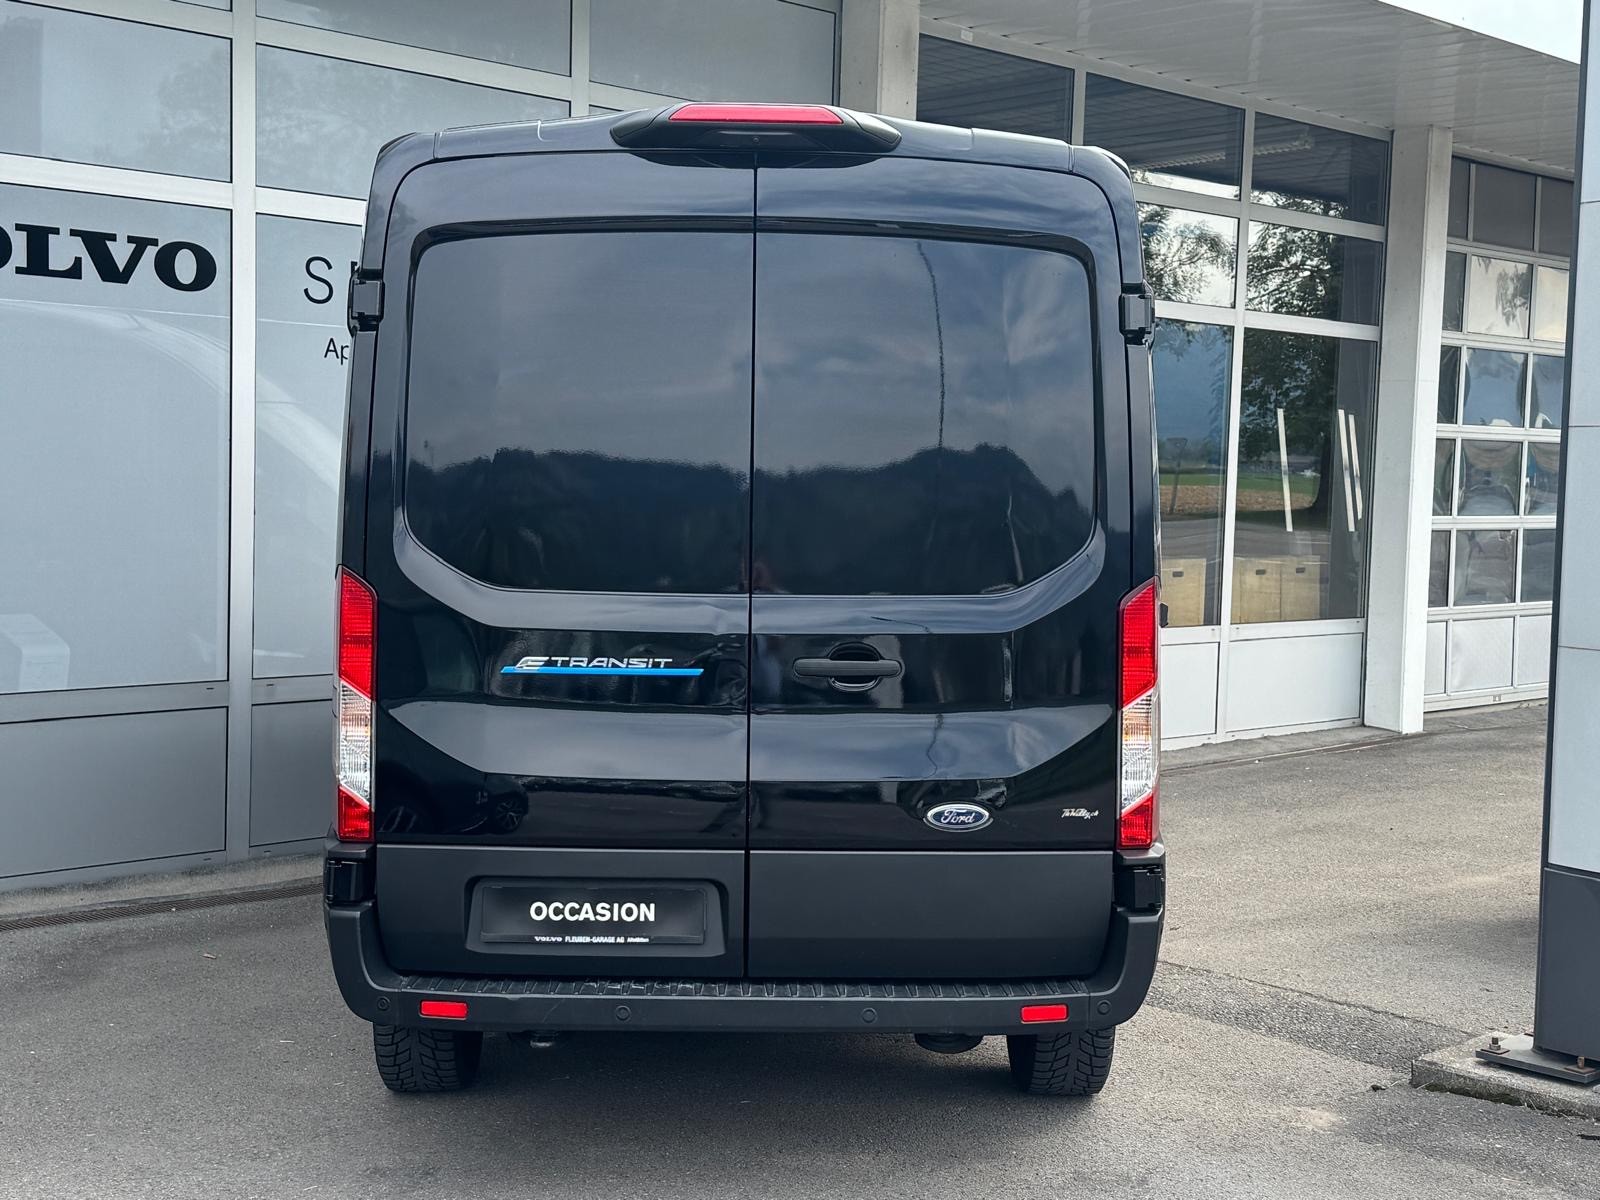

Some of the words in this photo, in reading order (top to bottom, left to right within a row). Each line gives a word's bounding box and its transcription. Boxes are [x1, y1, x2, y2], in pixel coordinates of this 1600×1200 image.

[0, 222, 217, 292] LVO
[940, 808, 976, 824] Ford
[529, 901, 656, 922] OCCASION
